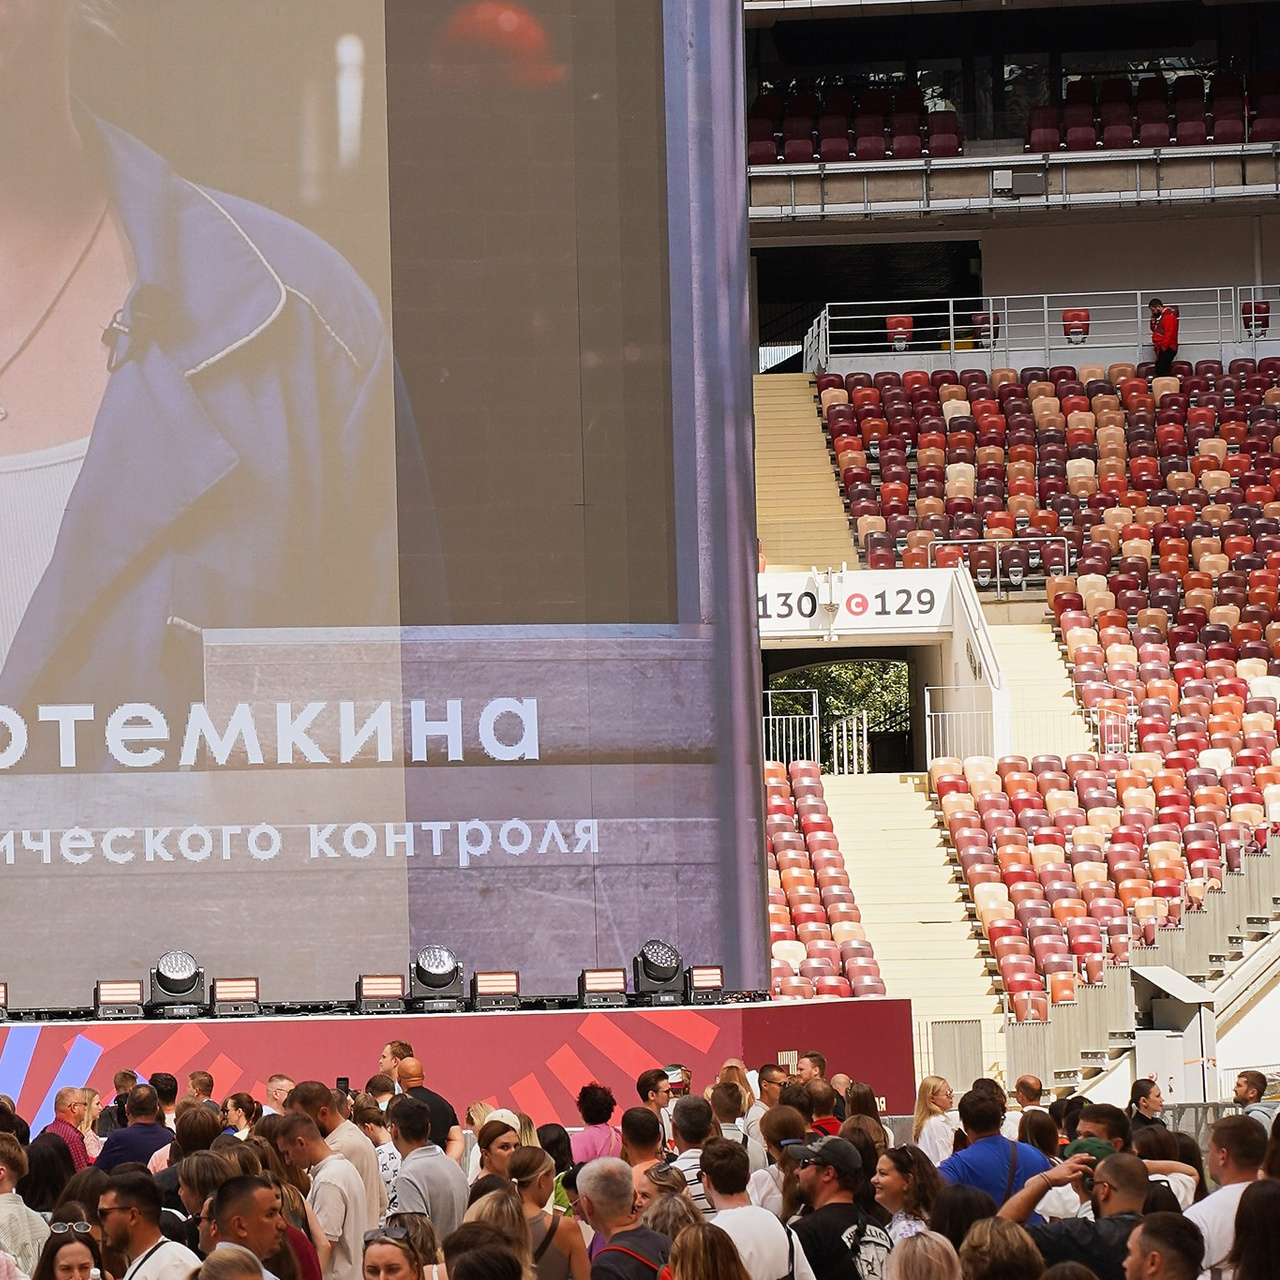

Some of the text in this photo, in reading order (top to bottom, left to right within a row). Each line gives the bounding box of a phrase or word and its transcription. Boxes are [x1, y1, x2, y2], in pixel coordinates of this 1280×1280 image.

[758, 593, 817, 619] 130
[875, 589, 935, 616] 129
[309, 818, 600, 868] контроля
